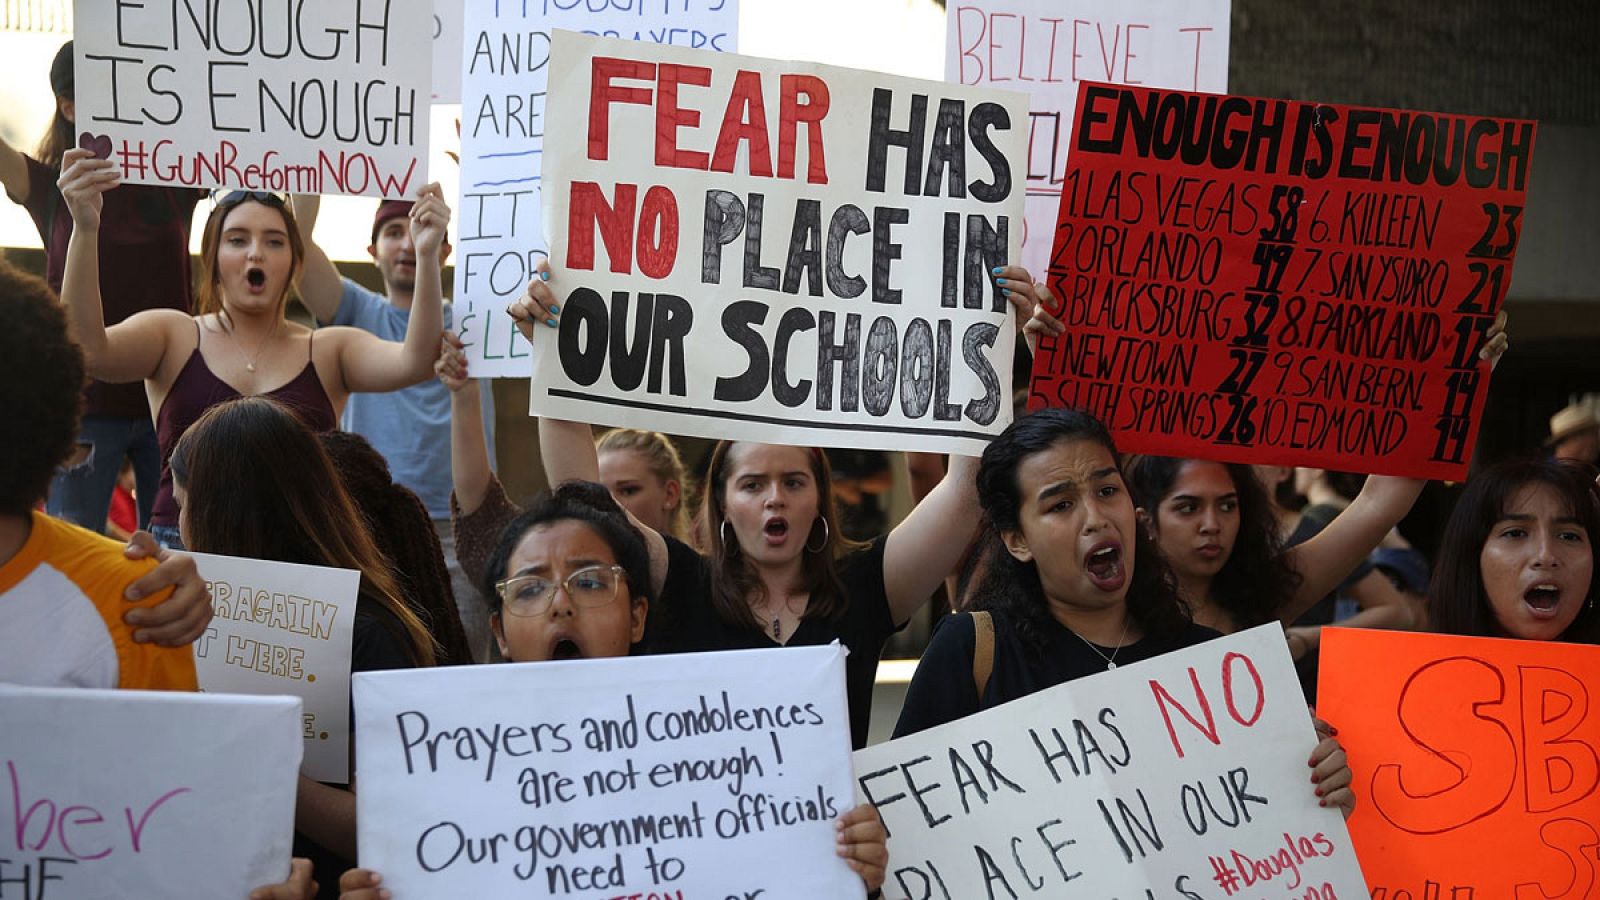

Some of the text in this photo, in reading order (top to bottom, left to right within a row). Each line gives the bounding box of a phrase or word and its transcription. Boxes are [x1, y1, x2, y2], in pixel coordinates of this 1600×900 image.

[469, 31, 551, 75] AND
[957, 7, 1149, 85] BELIEVE
[85, 55, 415, 146] IS ENOUGH
[473, 92, 546, 138] ARE
[587, 56, 830, 184] FEAR
[866, 87, 1012, 203] HAS
[1079, 86, 1287, 174] ENOUGH
[1288, 105, 1339, 179] IS
[1337, 110, 1533, 191] ENOUGH
[1156, 174, 1261, 236] VEGAS
[1260, 184, 1306, 242] 58
[1309, 190, 1523, 257] 6. KILLEEN 23
[565, 181, 1009, 314] NO PLACE IN
[1252, 242, 1296, 293] 49
[1320, 251, 1375, 300] SAN
[1373, 255, 1449, 308] YSIDRO
[1457, 262, 1504, 315] 21
[1232, 293, 1280, 346] 32
[1306, 301, 1442, 363] PARKLAND
[1453, 315, 1496, 369] 17
[558, 287, 1001, 426] OUR SCHOOLS
[1061, 333, 1198, 387] NEWTOWN
[1214, 351, 1268, 395] 27
[1293, 356, 1355, 400] SAN
[1356, 363, 1428, 411] BERN.
[1443, 371, 1480, 417] 14
[1121, 387, 1222, 440] SPRINGS
[1213, 393, 1258, 445] 26
[1290, 401, 1408, 456] EDMOND
[1433, 417, 1471, 464] 14
[225, 635, 316, 682] HERE.
[397, 691, 823, 781] Prayers and condolences
[858, 651, 1265, 838] FEAR HAS NO
[518, 766, 576, 808] are
[583, 758, 641, 798] not
[1096, 788, 1164, 864] IN
[1181, 767, 1268, 836] OUR
[416, 821, 508, 872] Our
[513, 800, 705, 880] government
[545, 847, 686, 895] need to
[1208, 832, 1335, 897] #Douglas
